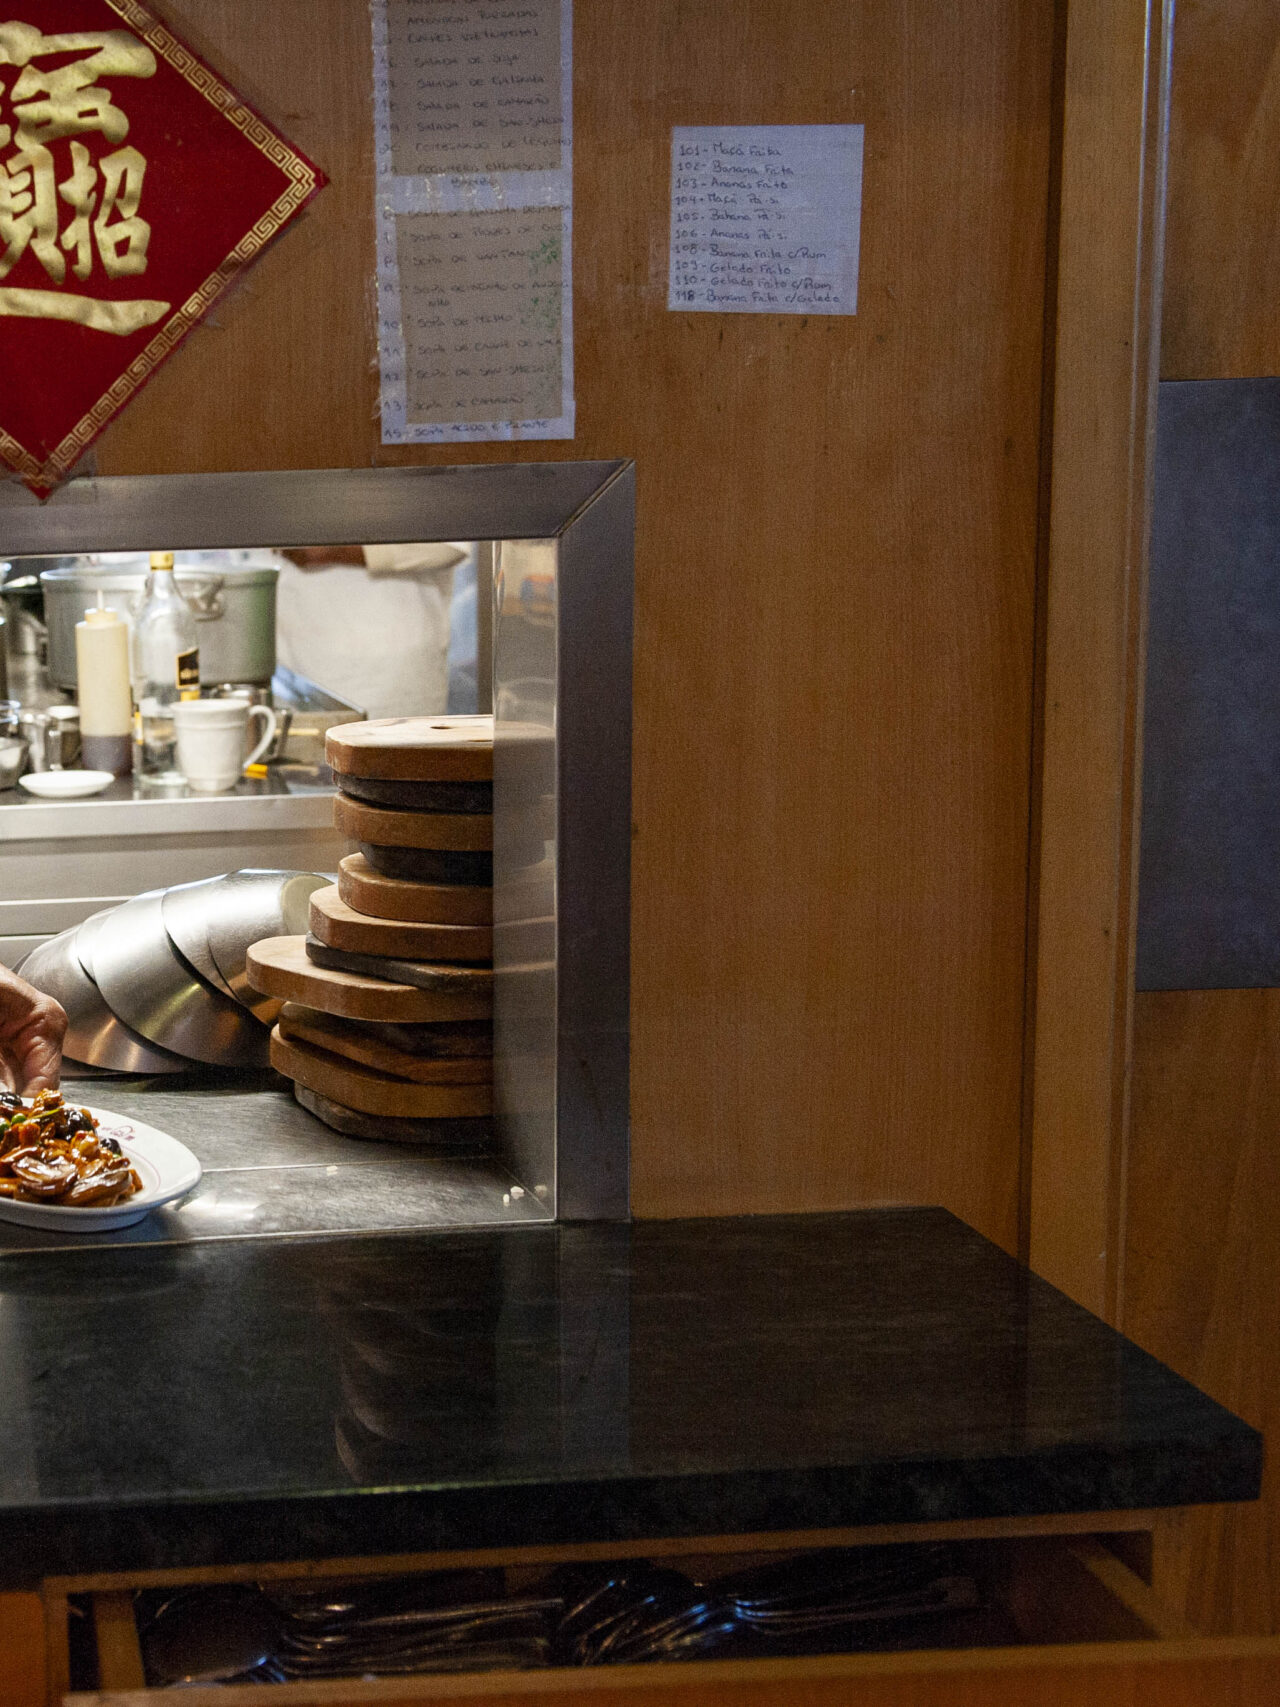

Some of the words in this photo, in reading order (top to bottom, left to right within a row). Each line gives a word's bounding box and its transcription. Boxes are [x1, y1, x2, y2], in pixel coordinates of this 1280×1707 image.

[712, 160, 759, 175] Banana
[709, 244, 751, 259] Banana
[709, 262, 754, 274] Gelado
[710, 274, 754, 287] Gelado
[706, 288, 748, 304] Banana
